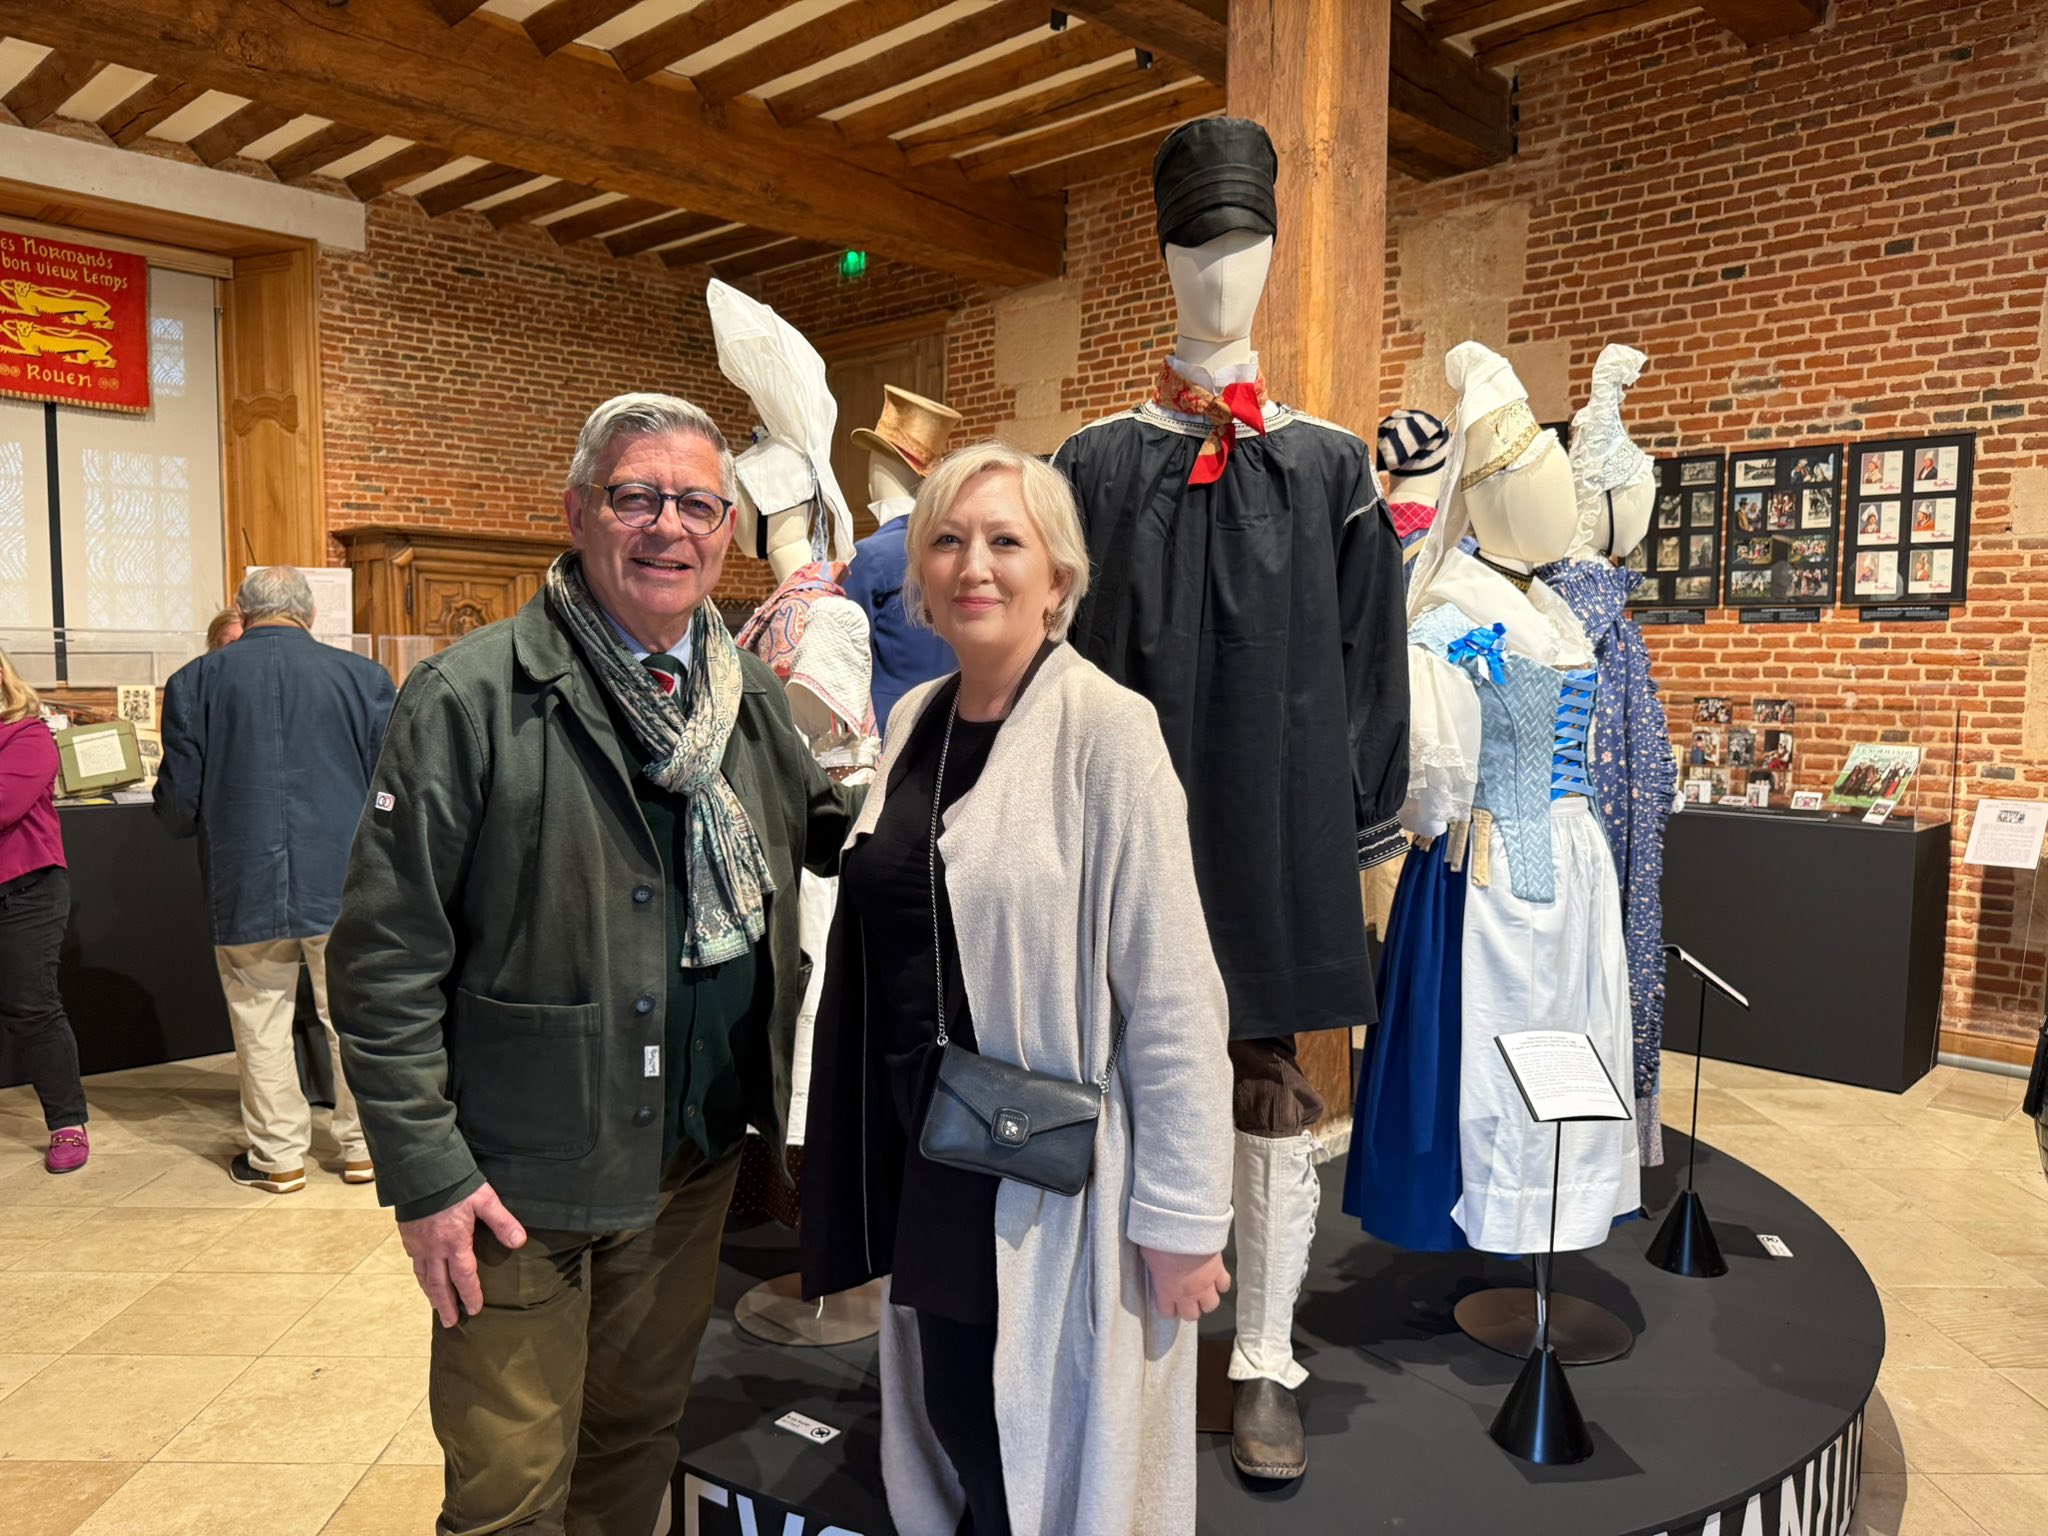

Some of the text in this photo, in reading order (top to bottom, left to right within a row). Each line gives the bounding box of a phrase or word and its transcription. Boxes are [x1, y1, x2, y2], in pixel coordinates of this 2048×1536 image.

[1, 250, 128, 292] bon vieux temps
[26, 363, 92, 388] Rouen
